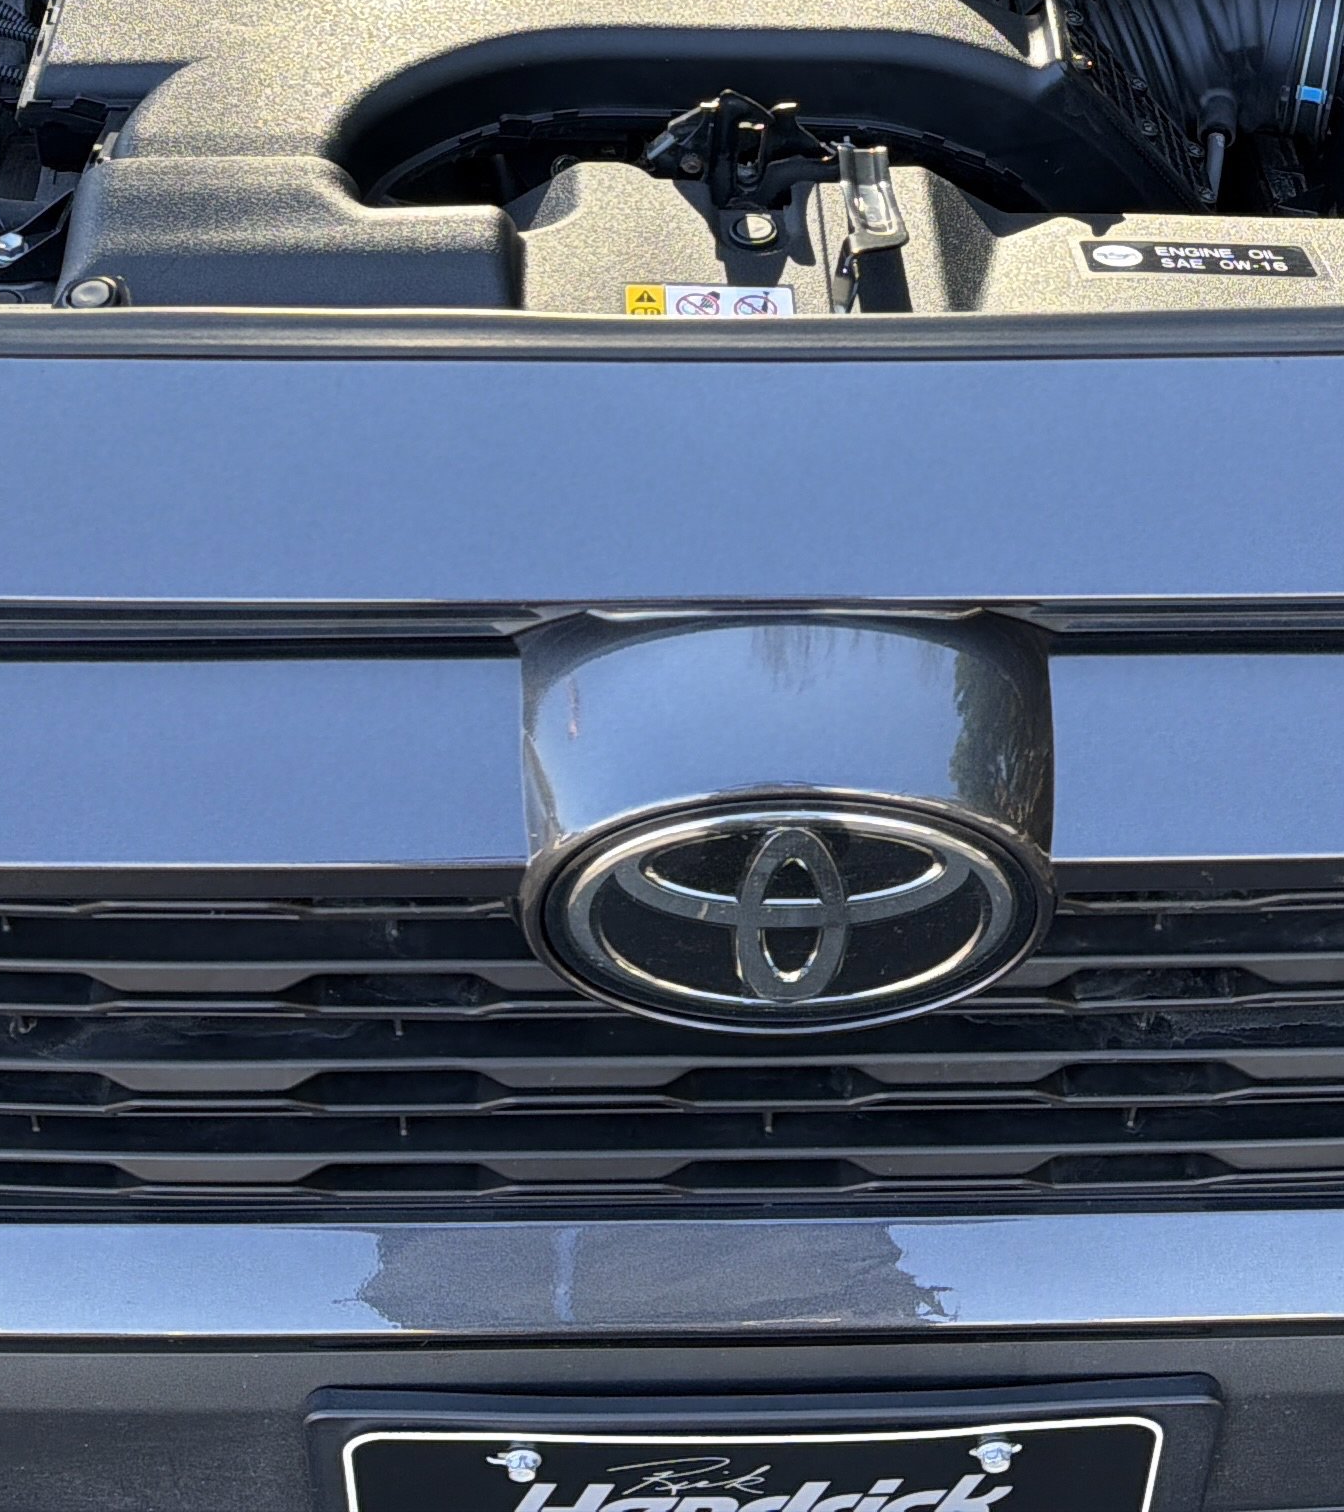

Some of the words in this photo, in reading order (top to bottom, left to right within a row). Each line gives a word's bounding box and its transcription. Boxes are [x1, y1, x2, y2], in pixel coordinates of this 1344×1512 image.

[1154, 246, 1235, 259] ENGINE
[1248, 249, 1285, 260] OIL
[1160, 258, 1206, 270] SAE
[1219, 259, 1289, 272] 0W-16
